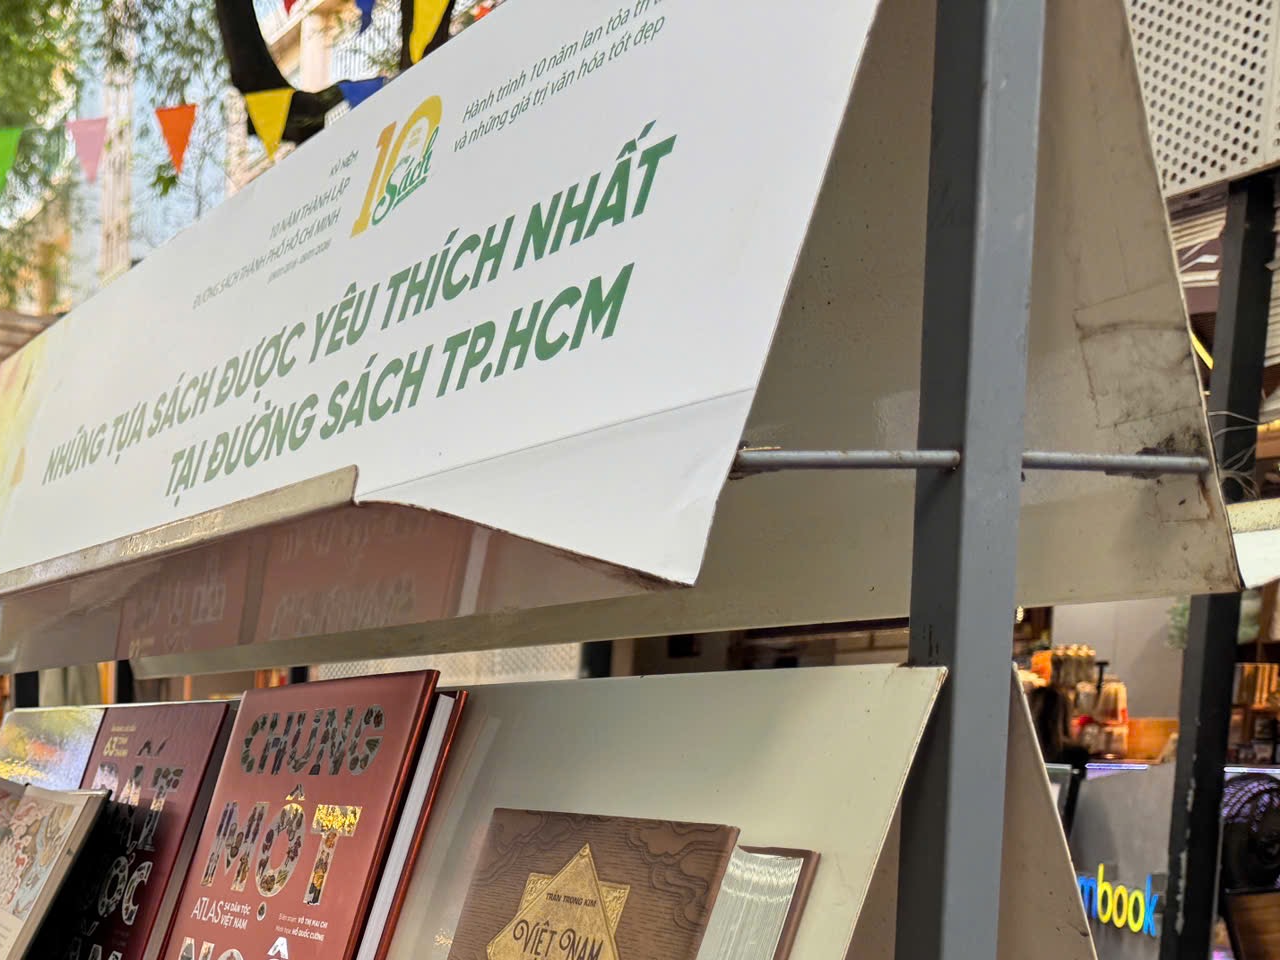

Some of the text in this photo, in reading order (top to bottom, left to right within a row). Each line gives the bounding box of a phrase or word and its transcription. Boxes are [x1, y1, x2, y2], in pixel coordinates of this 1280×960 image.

[454, 133, 468, 152] và
[469, 108, 509, 144] những
[510, 93, 531, 124] giá
[533, 82, 550, 106] trị
[551, 69, 575, 96] văn
[577, 51, 605, 81] hóa
[608, 31, 633, 62] tốt
[634, 15, 666, 46] đẹp
[462, 92, 495, 123] Hành
[497, 70, 526, 103] trình
[530, 57, 547, 82] 10
[547, 42, 579, 73] năm
[580, 25, 604, 51] lan
[41, 422, 108, 487] NHỮNG
[106, 399, 148, 465] TỰA
[146, 366, 218, 438] SÁCH
[216, 321, 306, 404] ĐƯỢC
[308, 281, 381, 365] YÊU
[380, 214, 516, 331] THÍCH
[512, 119, 678, 272] NHẤT
[165, 439, 209, 508] TẠI
[202, 393, 320, 484] ĐƯỜNG
[319, 343, 435, 440] SÁCH
[435, 261, 636, 399] TP.HCM
[240, 703, 385, 776] CHUNG
[200, 783, 363, 921] MỘT
[191, 896, 225, 925] ATLAS
[220, 914, 249, 930] VIỆT NAM
[223, 901, 231, 911] 54
[512, 918, 558, 960] VIỆT
